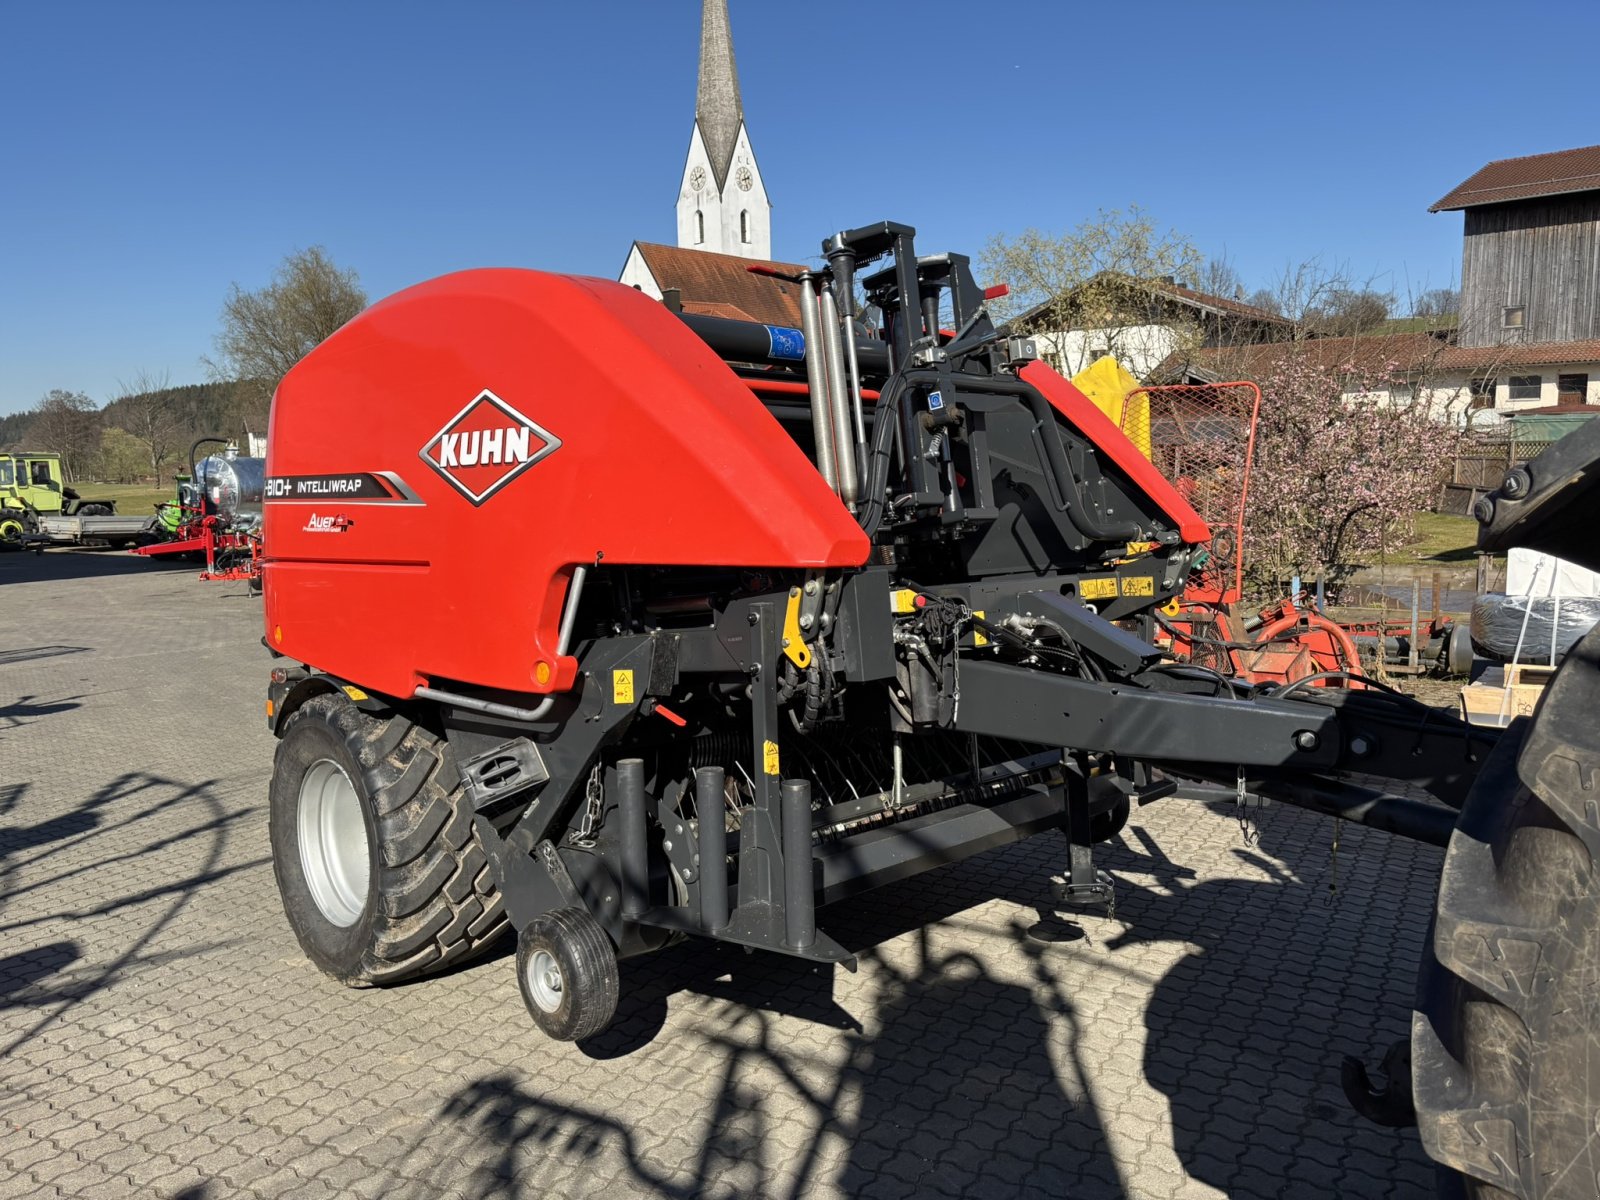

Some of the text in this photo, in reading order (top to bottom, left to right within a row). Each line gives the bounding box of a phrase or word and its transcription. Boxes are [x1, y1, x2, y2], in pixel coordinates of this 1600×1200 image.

[440, 427, 529, 467] KUHN
[264, 479, 362, 496] -BIO+ INTELLIWRAP
